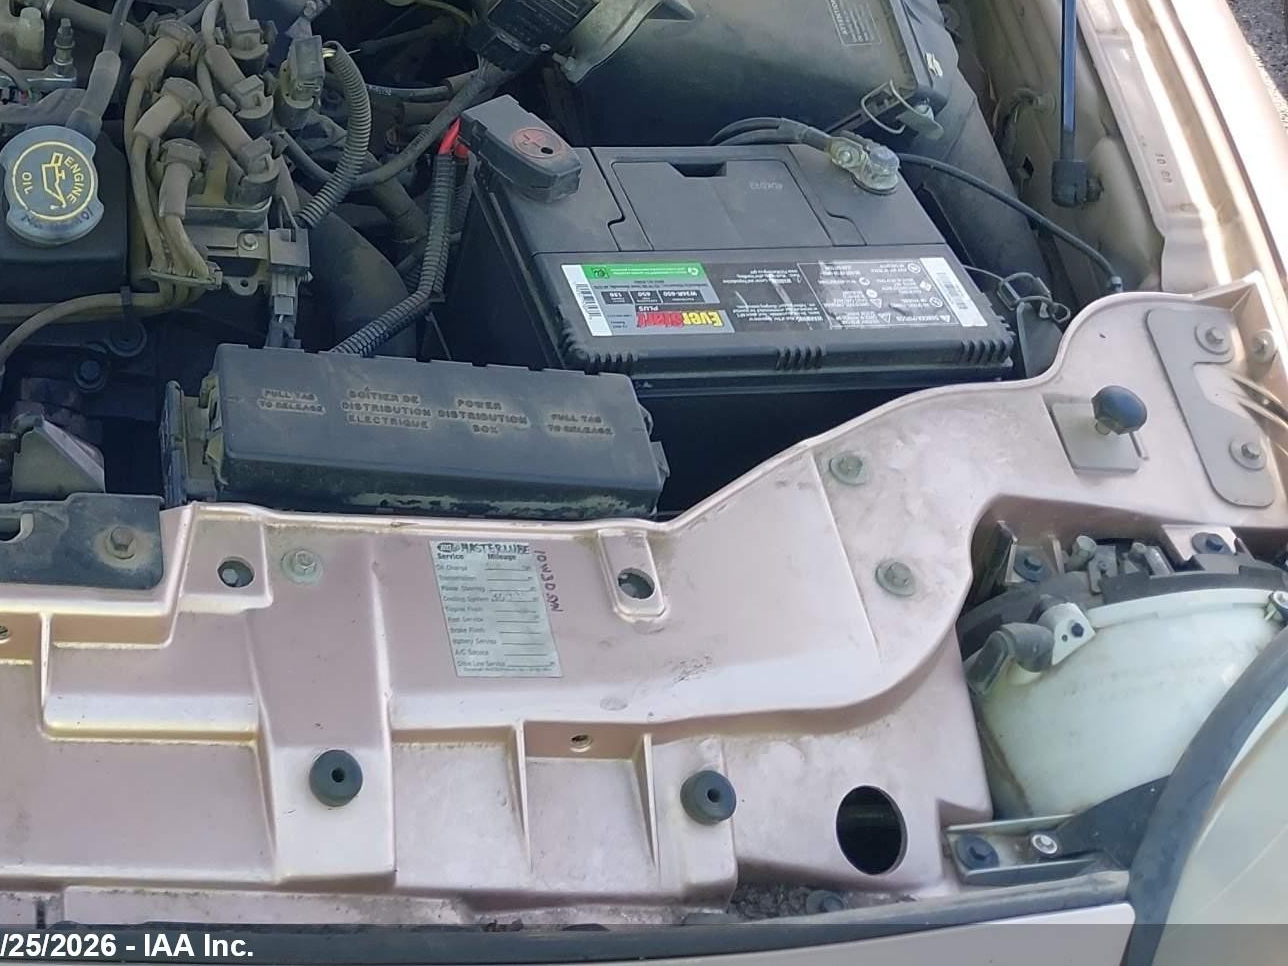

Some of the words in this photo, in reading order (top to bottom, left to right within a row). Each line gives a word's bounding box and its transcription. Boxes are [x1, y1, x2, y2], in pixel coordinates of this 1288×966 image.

[21, 172, 34, 194] OIL
[64, 155, 84, 203] ENGINE
[636, 310, 724, 329] EverStart
[264, 389, 291, 399] PULL
[294, 391, 316, 401] TAB
[402, 394, 421, 404] DE
[259, 400, 273, 409] TO
[275, 401, 325, 413] RELEASE
[341, 400, 432, 417] DISTRIBUTION
[456, 398, 503, 411] POWER
[437, 409, 529, 425] DISTRIBUTION
[550, 413, 578, 423] PULL
[580, 414, 603, 424] TAB
[472, 423, 500, 435] BOX
[547, 423, 561, 433] TO
[562, 425, 614, 436] RELEASE
[487, 553, 516, 561] Mileage
